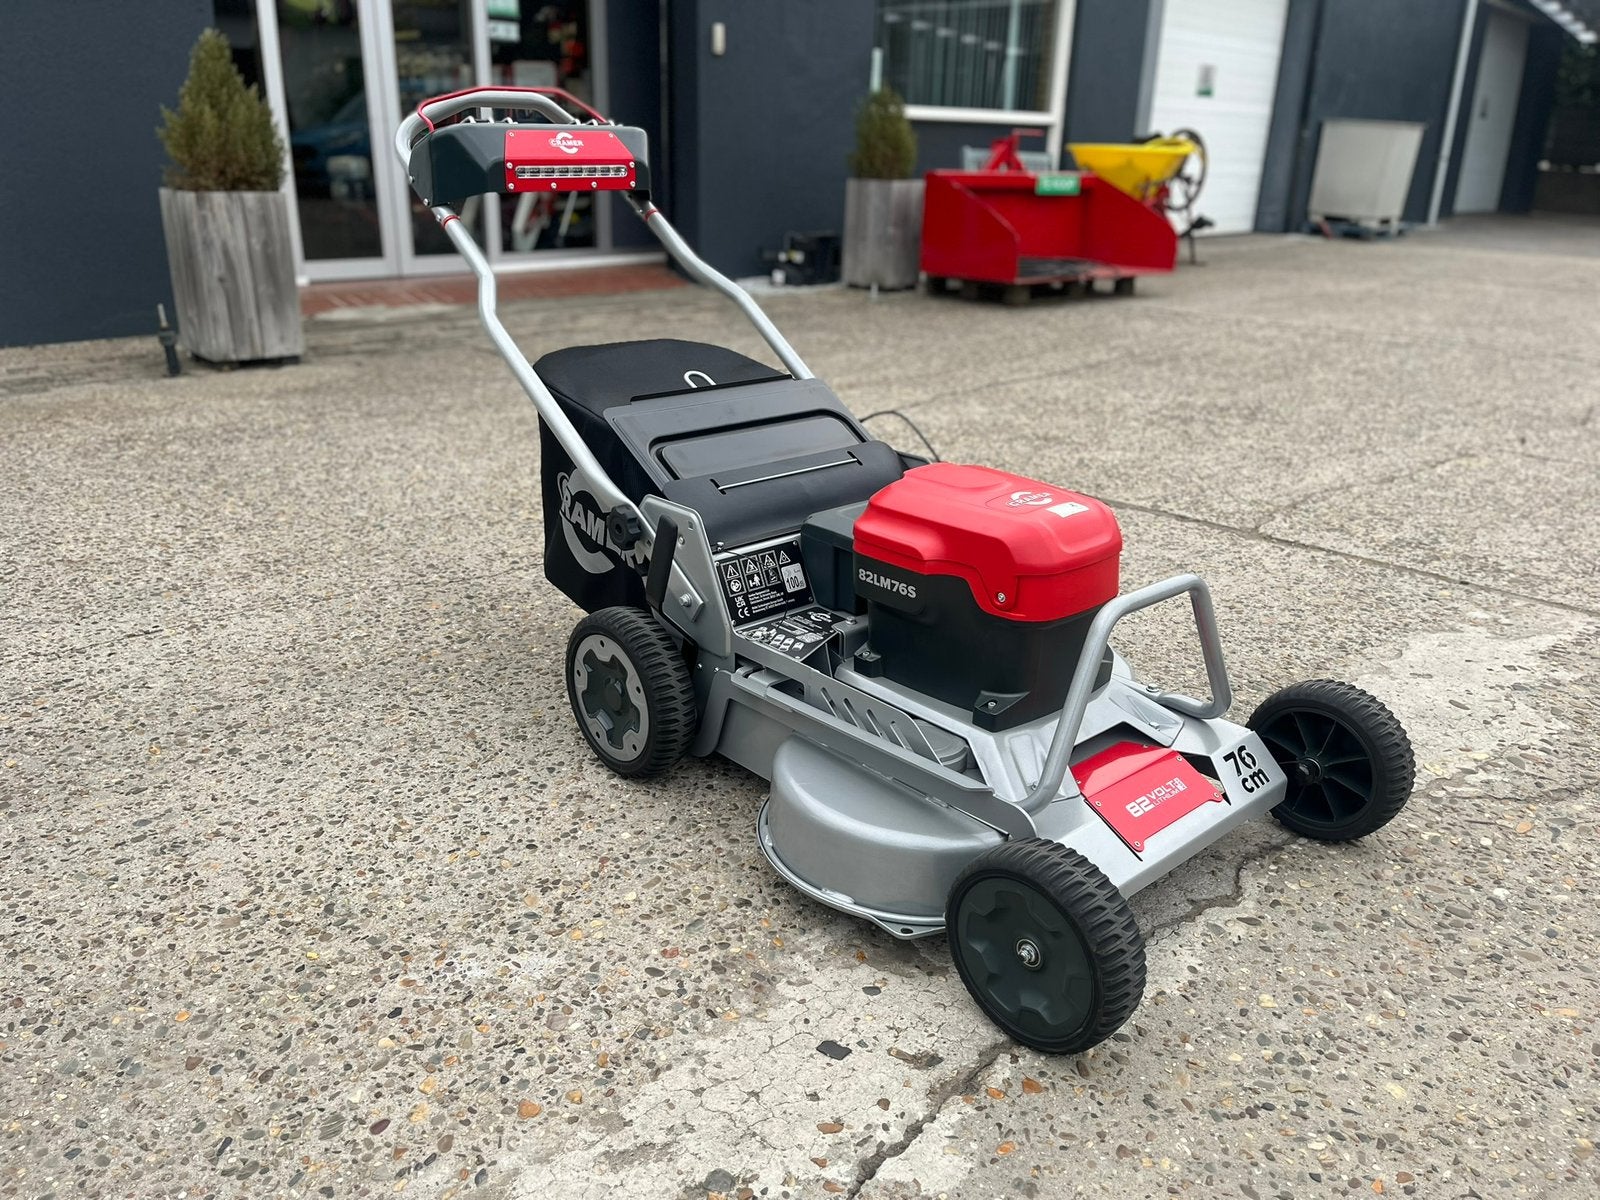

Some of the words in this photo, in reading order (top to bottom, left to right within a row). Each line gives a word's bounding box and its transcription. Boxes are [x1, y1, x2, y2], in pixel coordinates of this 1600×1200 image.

[786, 575, 799, 590] 100
[858, 568, 917, 599] 82LM76S
[738, 606, 750, 618] CE
[1223, 745, 1258, 777] 76
[1241, 767, 1271, 793] cm
[1125, 795, 1156, 818] 82
[1146, 779, 1176, 800] VOLT
